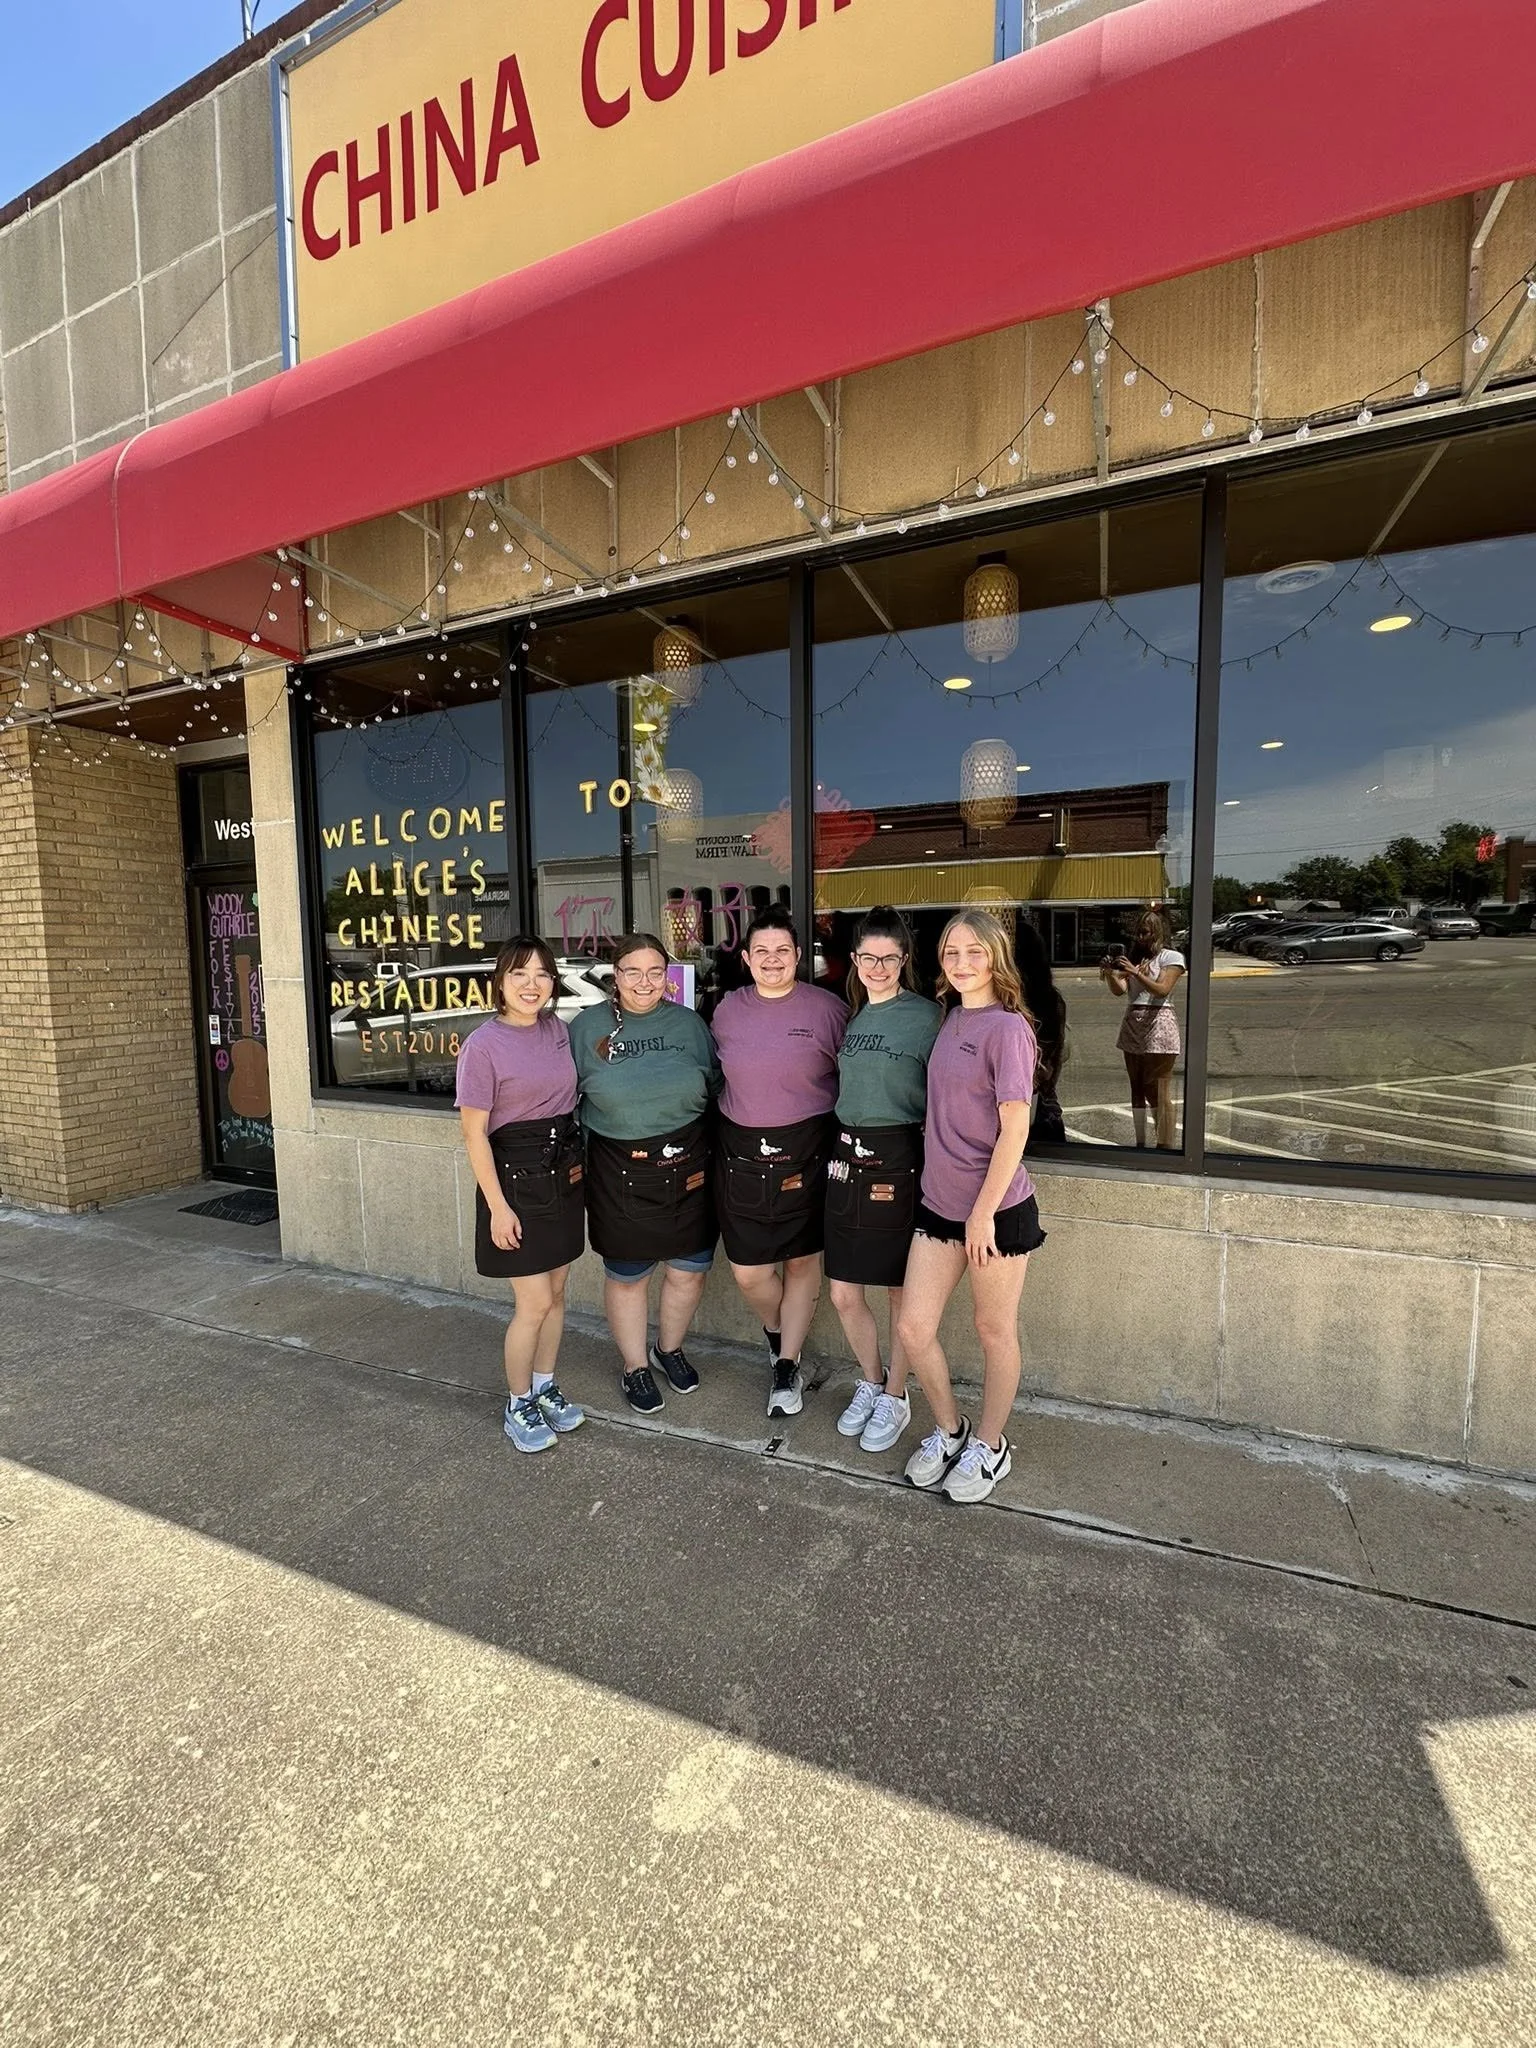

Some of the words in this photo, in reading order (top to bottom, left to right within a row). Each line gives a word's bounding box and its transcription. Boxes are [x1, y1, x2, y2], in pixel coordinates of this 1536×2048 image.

[302, 53, 540, 261] CHINA
[581, 0, 853, 128] CUI
[322, 799, 506, 849] WELCOME
[579, 778, 632, 814] TO
[345, 845, 487, 897] ALICE'S
[207, 892, 244, 915] WOODY
[210, 912, 258, 939] GUTHRIE
[337, 914, 486, 950] CHINESE
[209, 940, 221, 1009] FOLK
[222, 938, 236, 1044] FESTIVAL
[249, 971, 261, 1035] 2025
[331, 976, 496, 1012] RESTAURA
